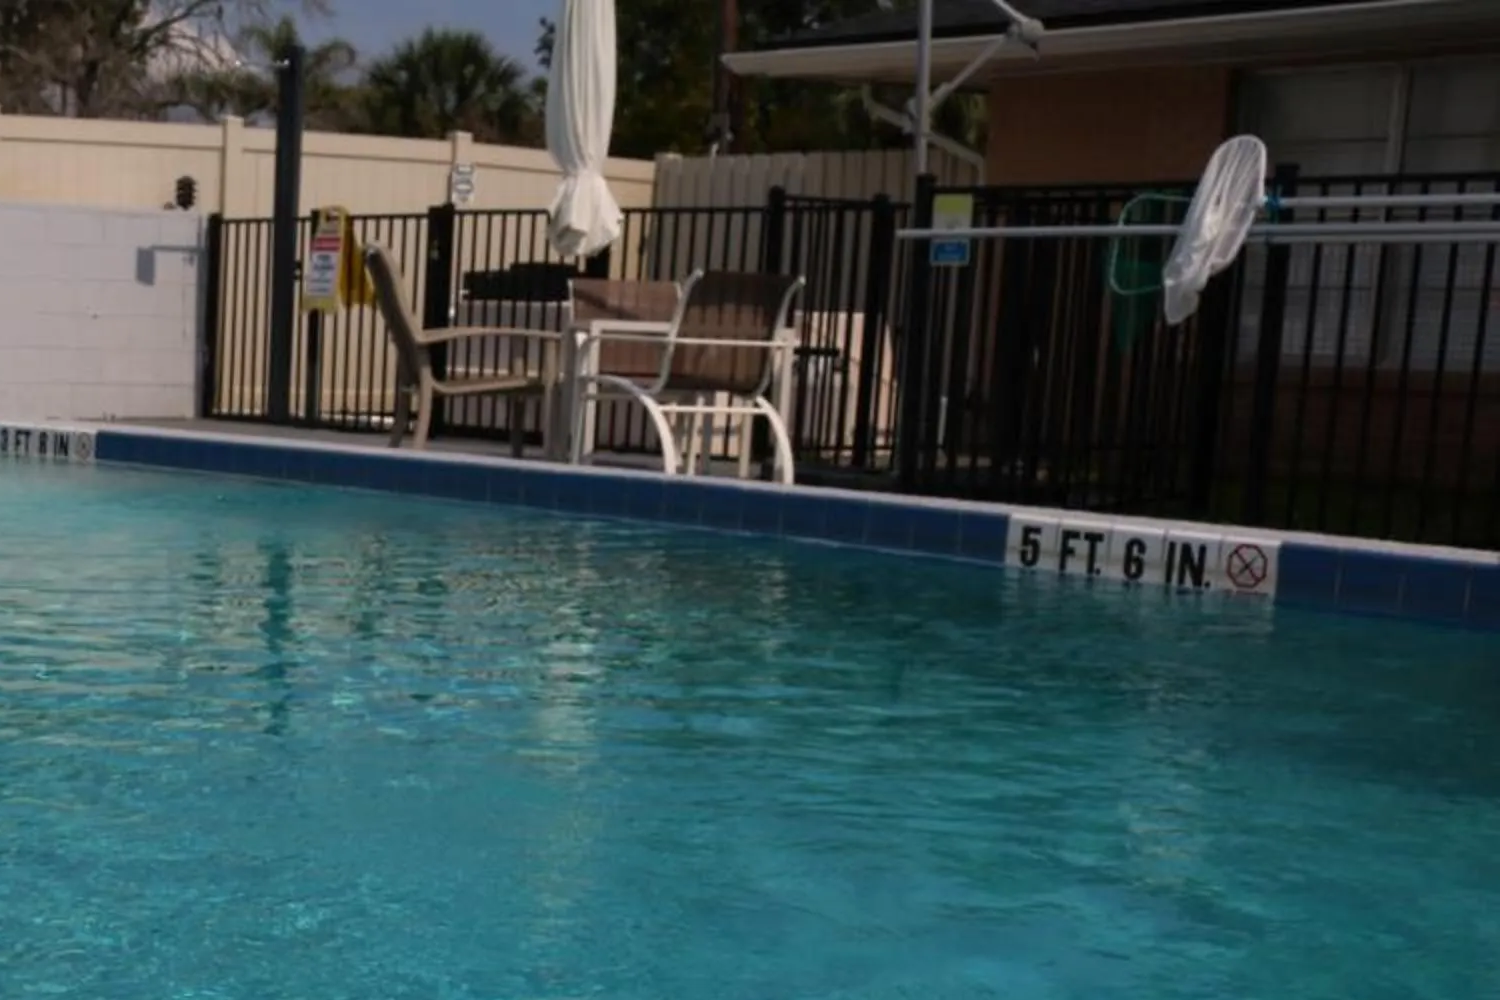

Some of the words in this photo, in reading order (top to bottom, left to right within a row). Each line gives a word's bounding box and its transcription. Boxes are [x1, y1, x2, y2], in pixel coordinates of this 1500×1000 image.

[1020, 526, 1042, 567] 5
[1058, 529, 1104, 576] FT.
[1123, 537, 1147, 580] 6
[1165, 541, 1211, 588] IN.
